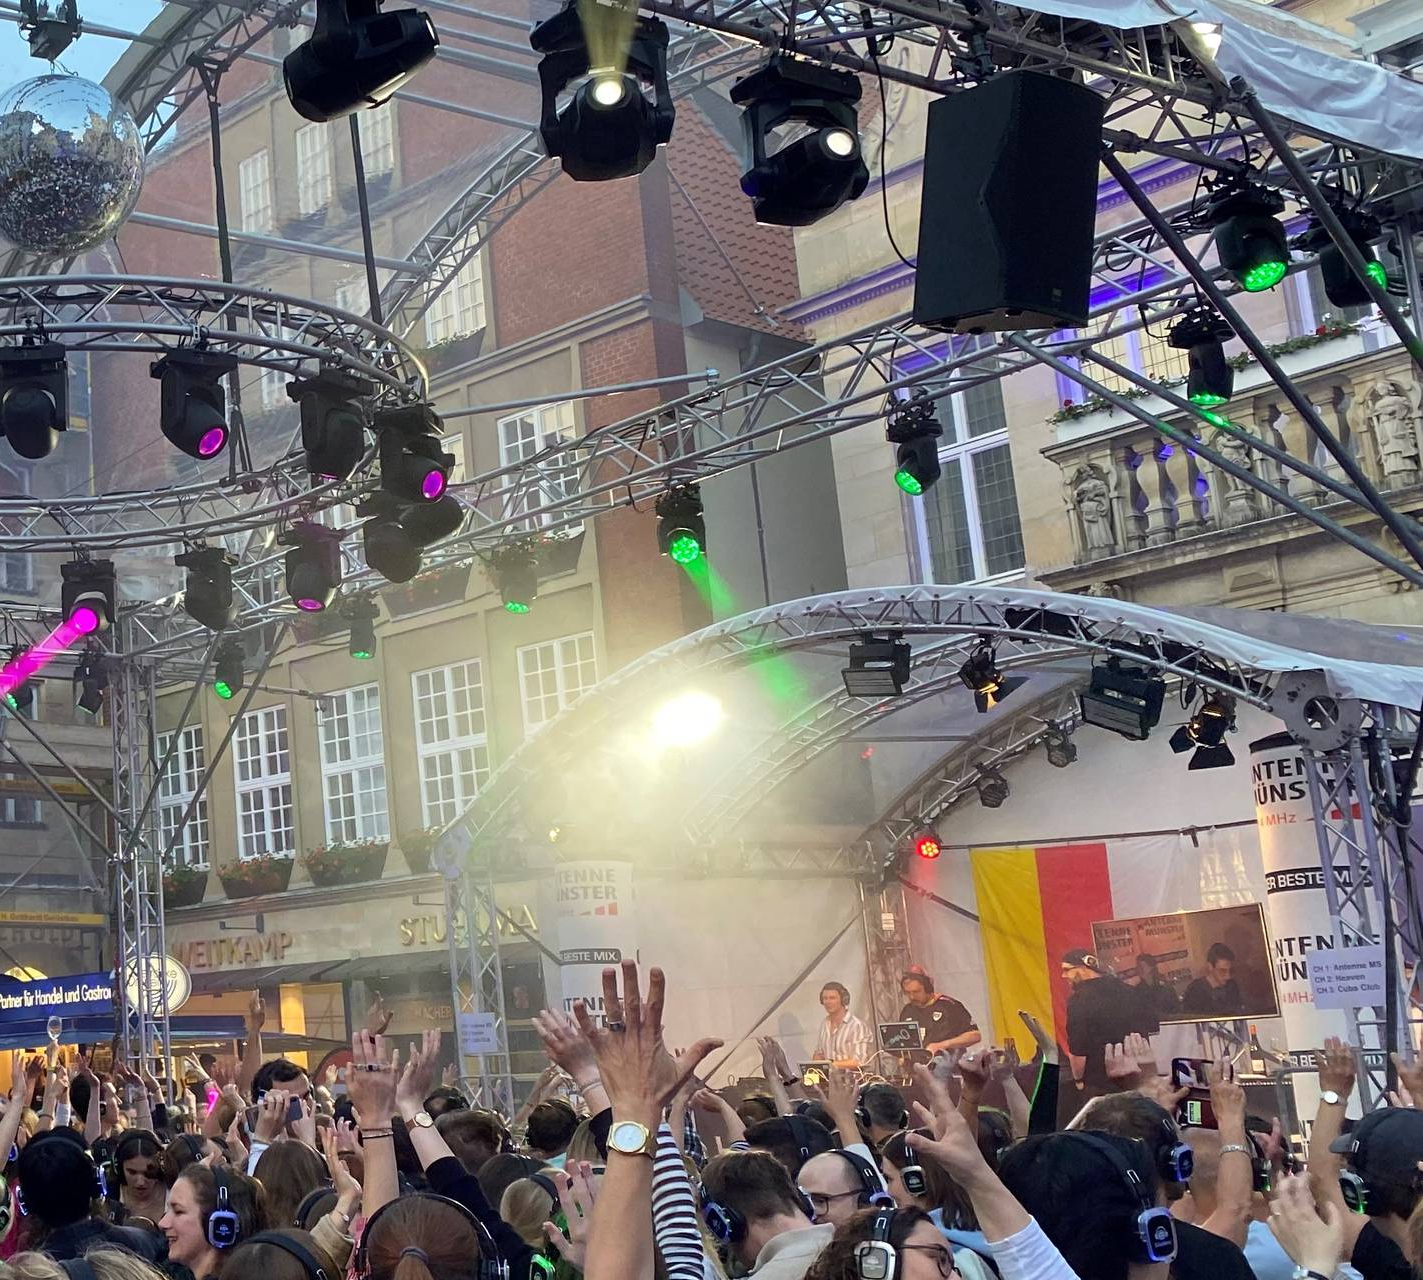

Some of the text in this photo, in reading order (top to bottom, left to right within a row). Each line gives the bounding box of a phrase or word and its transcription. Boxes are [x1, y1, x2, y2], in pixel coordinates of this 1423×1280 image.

[1278, 871, 1326, 888] BESTE
[172, 931, 293, 968] WEITKAMP
[24, 990, 35, 1007] für
[35, 986, 63, 1005] Handel
[64, 984, 79, 1002] und
